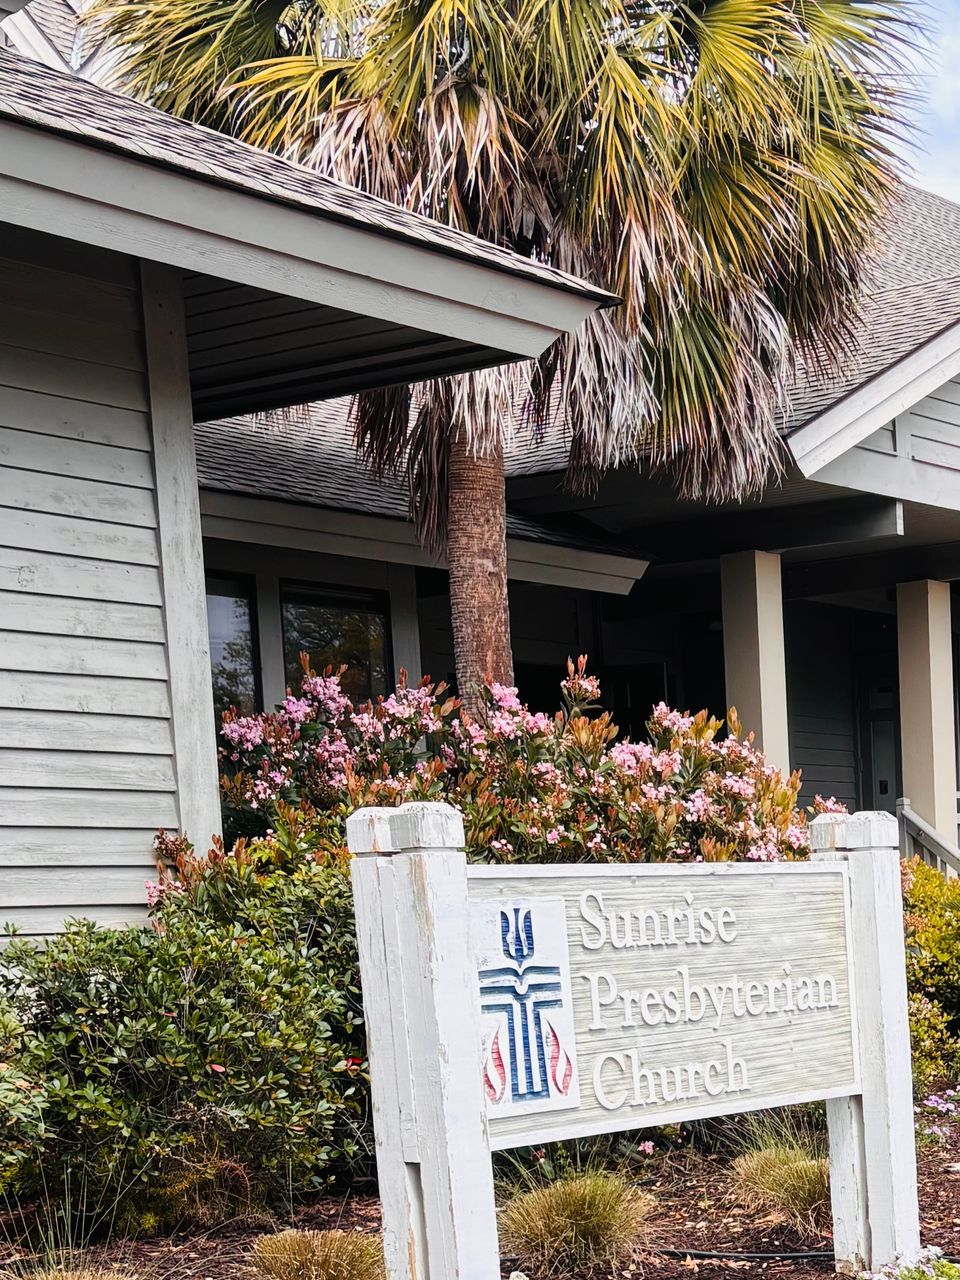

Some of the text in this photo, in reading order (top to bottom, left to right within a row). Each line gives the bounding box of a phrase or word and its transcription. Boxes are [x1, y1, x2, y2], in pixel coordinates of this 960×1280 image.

[580, 890, 738, 950] Sunrise
[580, 964, 840, 1030] Presbyterian
[594, 1041, 751, 1110] Church
